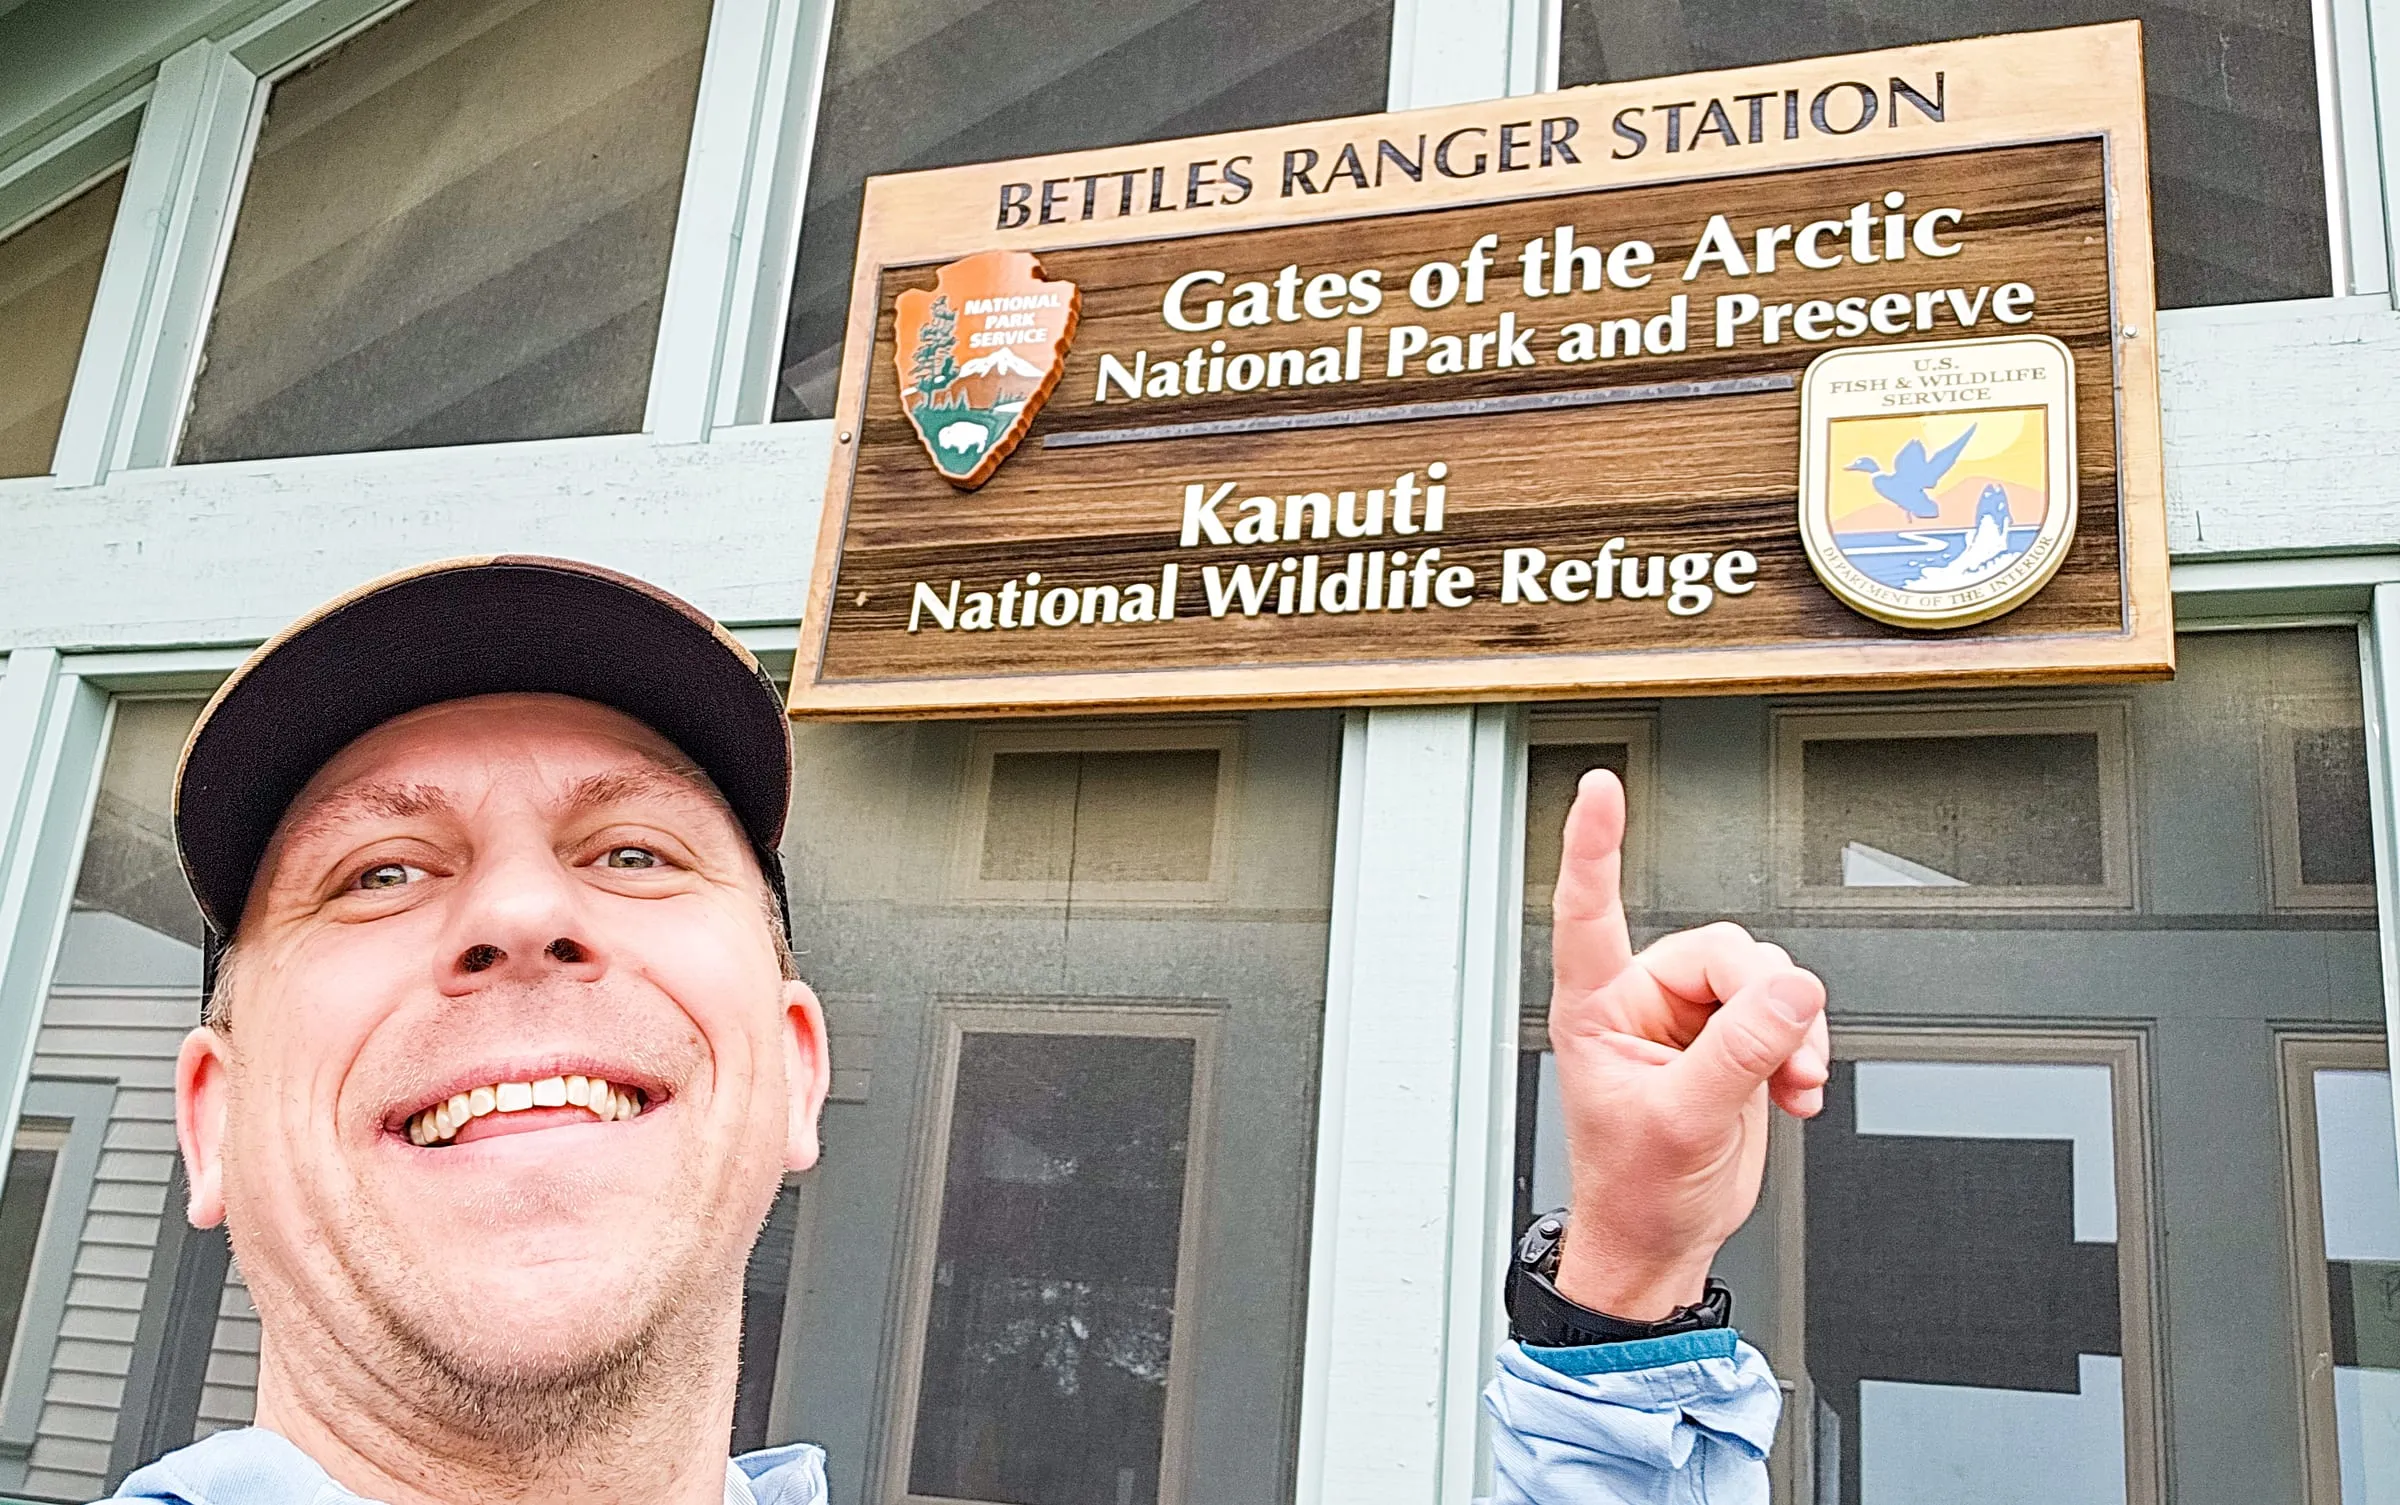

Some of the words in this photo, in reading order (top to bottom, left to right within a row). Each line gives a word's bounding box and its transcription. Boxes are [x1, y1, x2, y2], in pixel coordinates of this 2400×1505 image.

[996, 155, 1253, 230] BETTLES
[1279, 115, 1581, 198] RANGER
[1611, 71, 1945, 160] STATION
[1162, 264, 1383, 333] Gates
[1408, 233, 1498, 310] of
[1518, 224, 1656, 298] the
[1681, 190, 1964, 283] Arctic
[964, 294, 1061, 315] NATIONAL
[985, 313, 1035, 329] PARK
[969, 329, 1048, 347] SERVICE
[1094, 326, 1363, 402] National
[1387, 311, 1536, 378] Park
[1556, 295, 1688, 362] and
[1714, 281, 2036, 349] Preserve
[1829, 377, 1888, 394] FISH
[1895, 377, 1913, 390] &
[1918, 366, 2048, 389] WILDLIFE
[1913, 357, 1961, 372] U.S.
[1881, 388, 1993, 408] SERVICE
[1179, 461, 1448, 548] Kanuti
[907, 563, 1179, 633] National
[1201, 548, 1475, 618] Wildlife
[1500, 536, 1758, 616] Refuge
[1823, 546, 1912, 606] DEPARTMENT
[1919, 596, 1942, 607] OF
[1951, 590, 1985, 605] THE
[1991, 535, 2055, 592] INTERIOR
